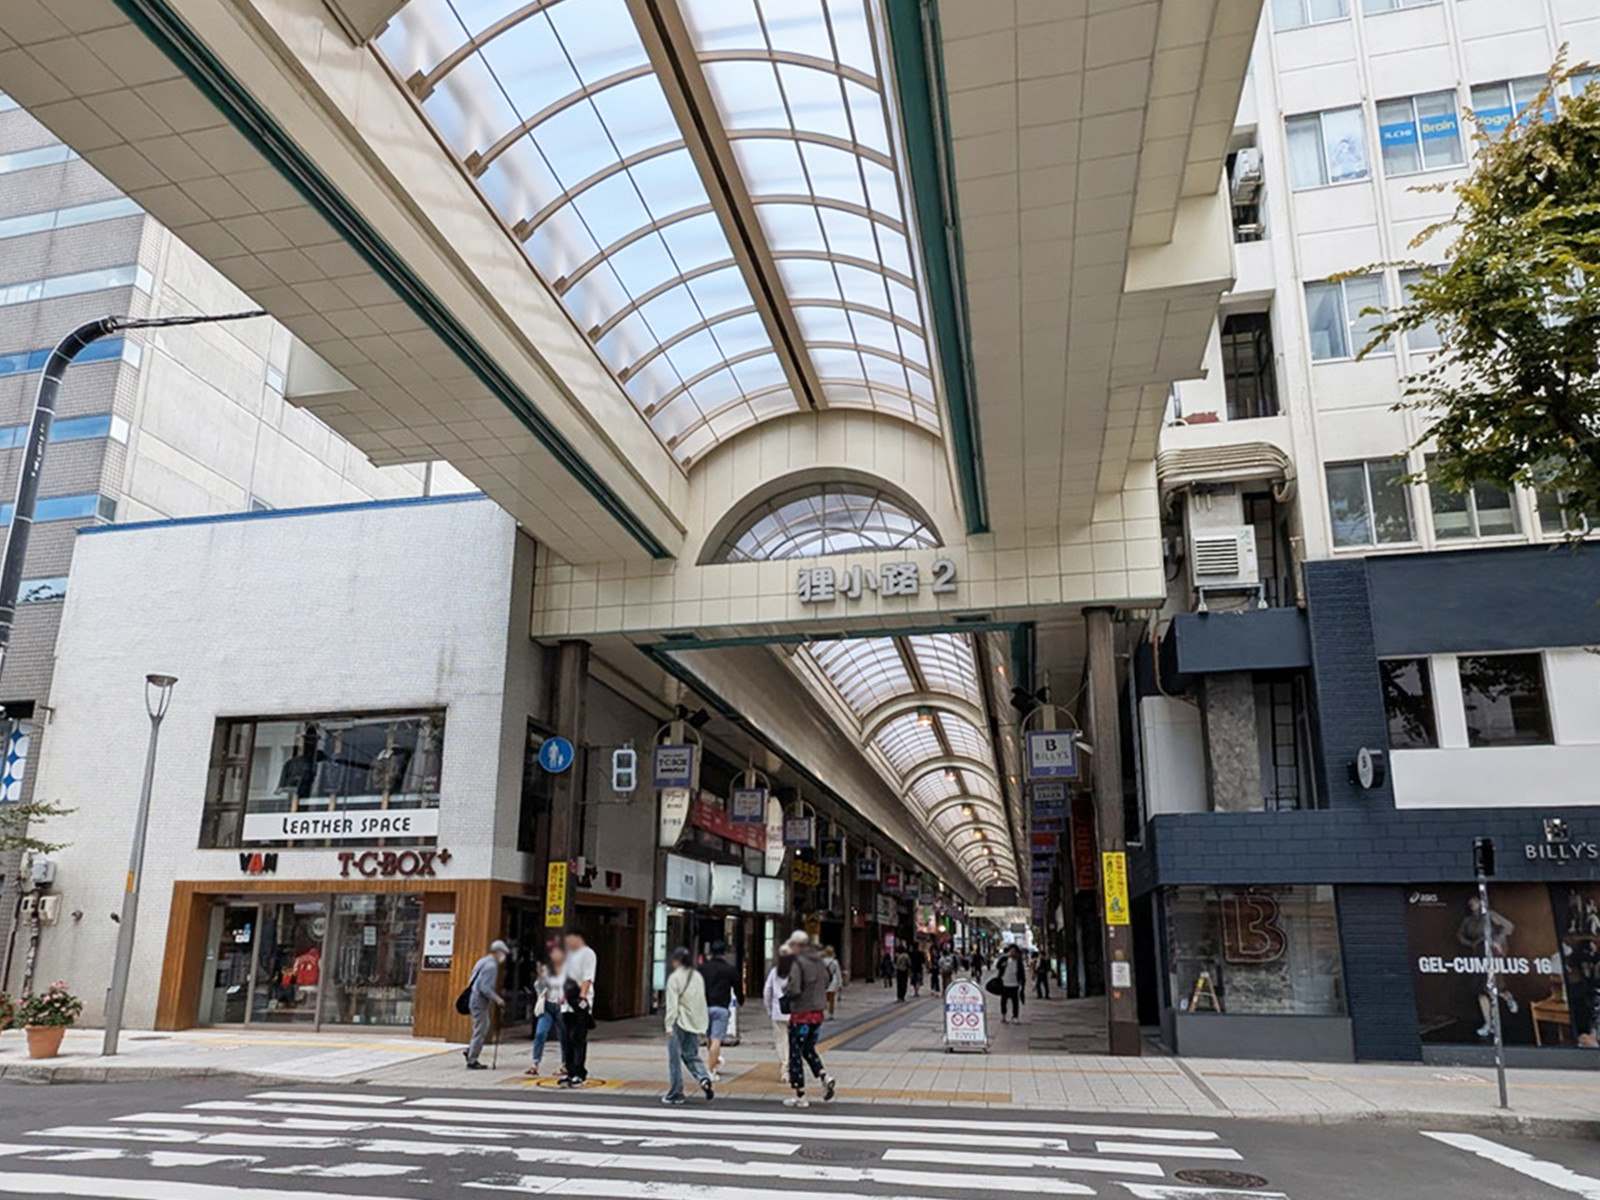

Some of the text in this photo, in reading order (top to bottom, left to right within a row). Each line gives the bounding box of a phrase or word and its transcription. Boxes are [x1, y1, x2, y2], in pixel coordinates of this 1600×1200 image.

[1422, 119, 1456, 133] Brain
[798, 562, 919, 603] 狸小路
[360, 817, 411, 833] SPACE
[1525, 842, 1599, 859] BILLY'S
[239, 852, 279, 875] VAN
[1220, 894, 1288, 965] B
[1418, 956, 1553, 975] GEL-CUMULUS 16
